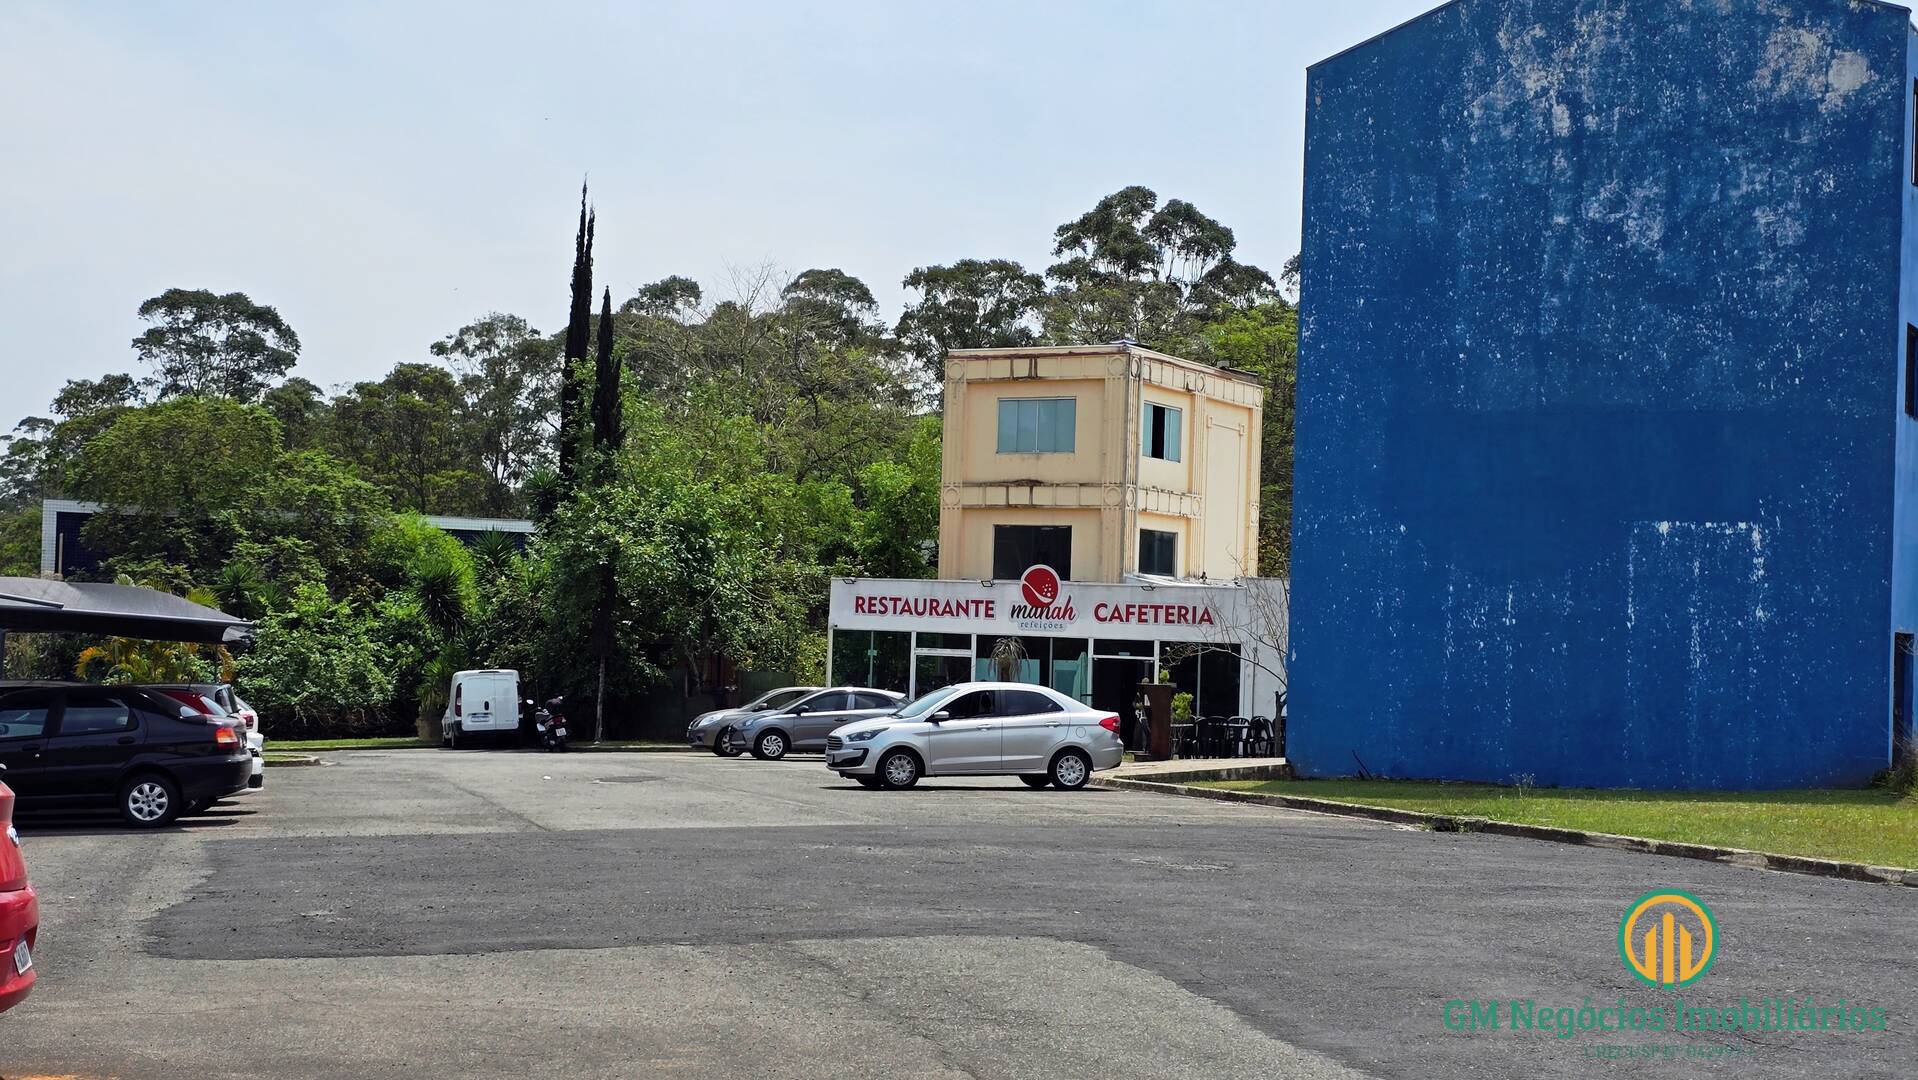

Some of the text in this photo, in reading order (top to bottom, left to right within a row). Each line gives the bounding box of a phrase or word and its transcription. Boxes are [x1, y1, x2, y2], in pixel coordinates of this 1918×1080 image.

[855, 596, 995, 619] RESTAURANTE
[1010, 594, 1077, 621] manah
[1094, 602, 1214, 626] CAFETERIA
[1020, 620, 1064, 630] refeições
